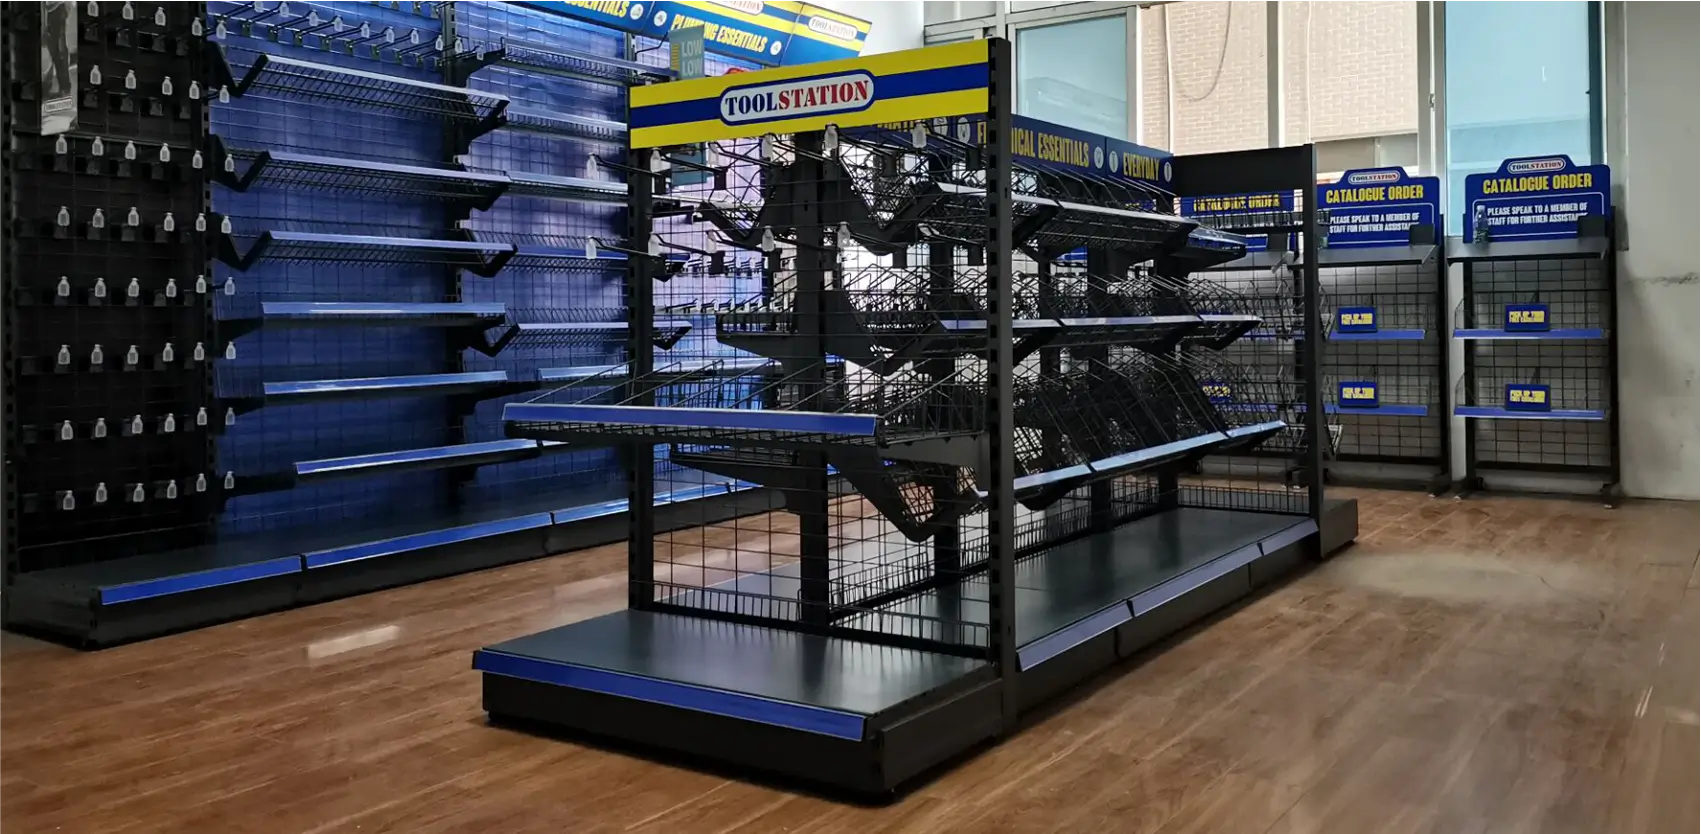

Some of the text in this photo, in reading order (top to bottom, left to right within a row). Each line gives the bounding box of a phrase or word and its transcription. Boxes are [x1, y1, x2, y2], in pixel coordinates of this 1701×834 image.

[681, 39, 702, 57] LOW
[717, 25, 768, 53] ESSENTIALS
[681, 57, 702, 76] LOW
[725, 80, 869, 116] TOOLSTATION
[1038, 132, 1090, 168] ESSENTIALS
[1123, 152, 1160, 181] EVERYDAY
[1511, 161, 1562, 170] TOOLSTATION
[1352, 174, 1397, 182] TOOLSTATION
[1483, 173, 1592, 194] CATALOGUE ORDER
[1325, 184, 1424, 204] CATALOGUE ORDER
[1487, 201, 1589, 216] PLEASE SPEAK TO A MEMBER OF
[1329, 211, 1420, 225] PLEASE SPEAK TO A MEMBER OF
[1486, 217, 1506, 226] STAFF
[1506, 216, 1519, 225] FOR
[1519, 214, 1549, 224] FURTHER
[1328, 225, 1347, 235] STAFF
[1347, 224, 1359, 233] FOR
[1358, 222, 1384, 233] FURTHER
